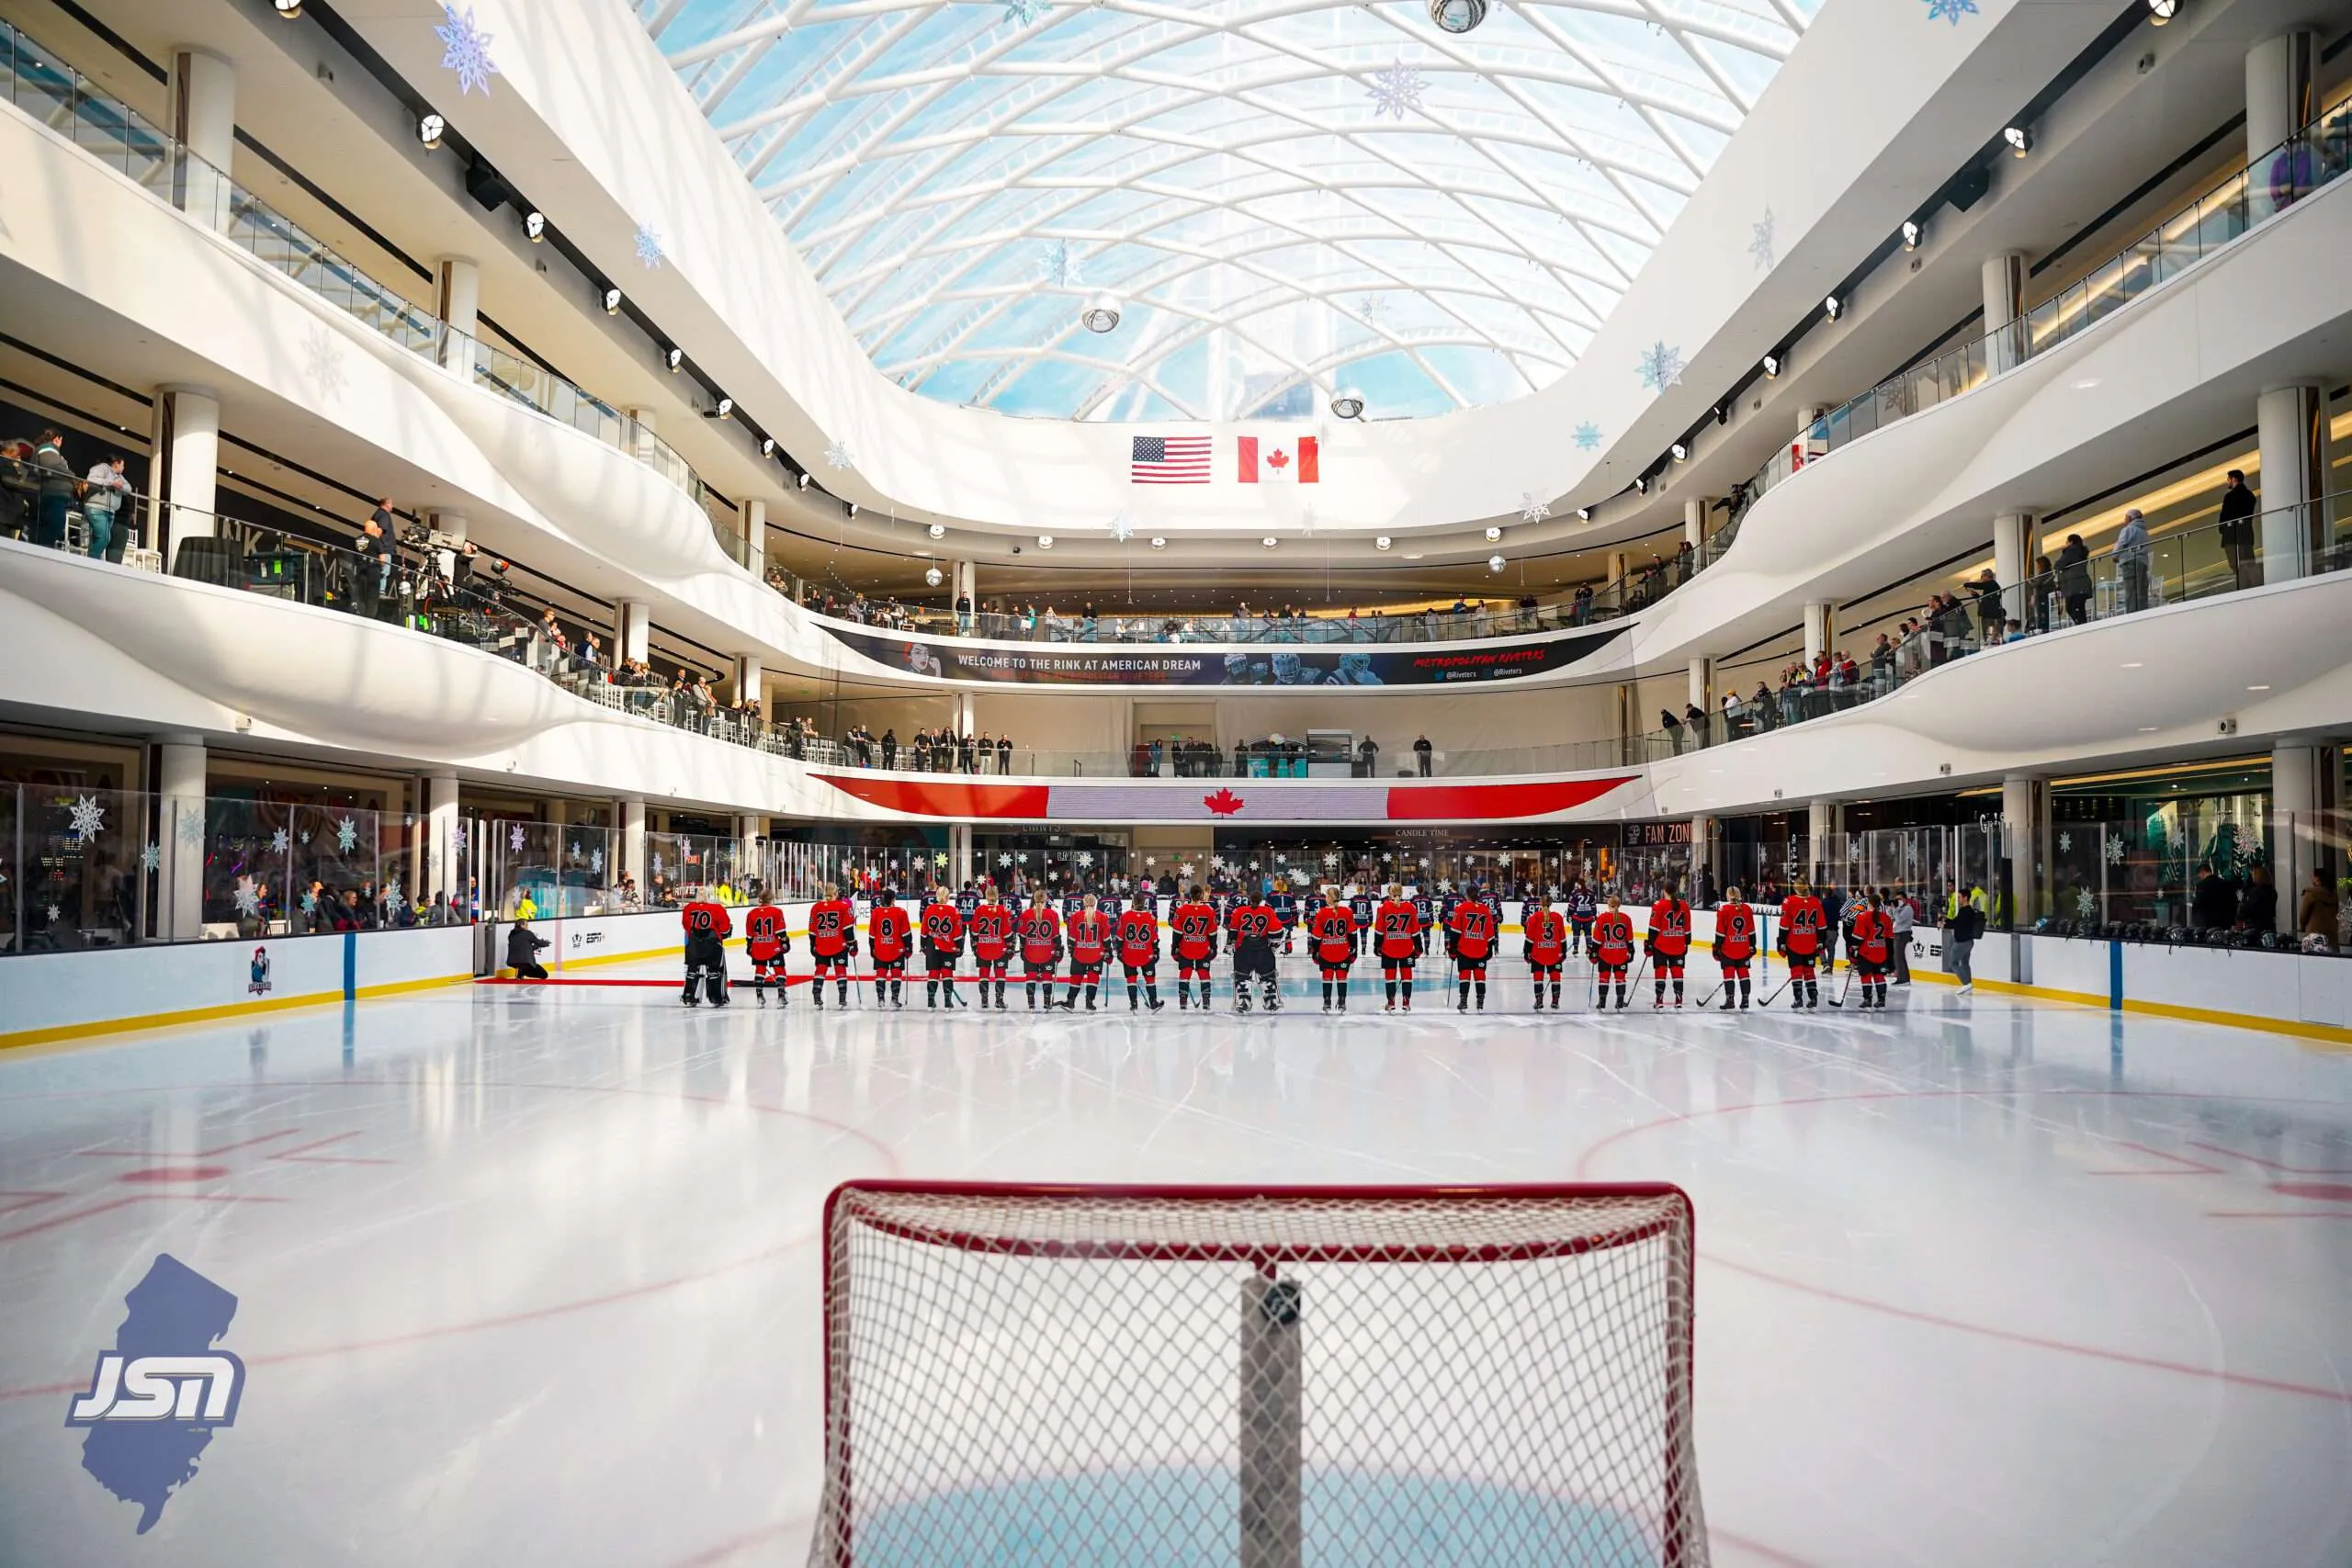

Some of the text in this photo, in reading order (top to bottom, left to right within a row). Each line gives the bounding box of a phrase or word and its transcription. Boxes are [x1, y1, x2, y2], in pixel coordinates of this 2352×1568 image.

[958, 654, 1202, 671] WELCOME TO THE RINK AT AMERICAN DREAM
[1413, 649, 1545, 668] METROPOLITAN RIVETERS
[1446, 668, 1522, 680] @Riveters @Riveters
[1396, 829, 1449, 837] CANDLE TIME
[1645, 825, 1665, 843] FAN
[961, 899, 974, 910] 44
[1071, 900, 1081, 911] 15
[1104, 902, 1114, 914] 21
[1356, 903, 1366, 914] 10
[690, 910, 712, 929] 70
[753, 918, 773, 936] 41
[817, 911, 840, 930] 25
[928, 916, 953, 934] 96
[978, 917, 1001, 935] 21
[1183, 917, 1208, 935] 67
[1240, 913, 1269, 935] 29
[1385, 914, 1411, 932] 27
[1466, 912, 1487, 932] 71
[1665, 911, 1684, 930] 14
[1732, 916, 1746, 935] 9
[1793, 909, 1818, 928] 44
[881, 919, 893, 937] 8
[1026, 920, 1052, 939] 20
[1079, 922, 1100, 942] 11
[1125, 922, 1150, 942] 86
[1323, 919, 1347, 937] 48
[1543, 921, 1555, 942] 3
[1602, 923, 1626, 942] 10
[1874, 923, 1885, 942] 2
